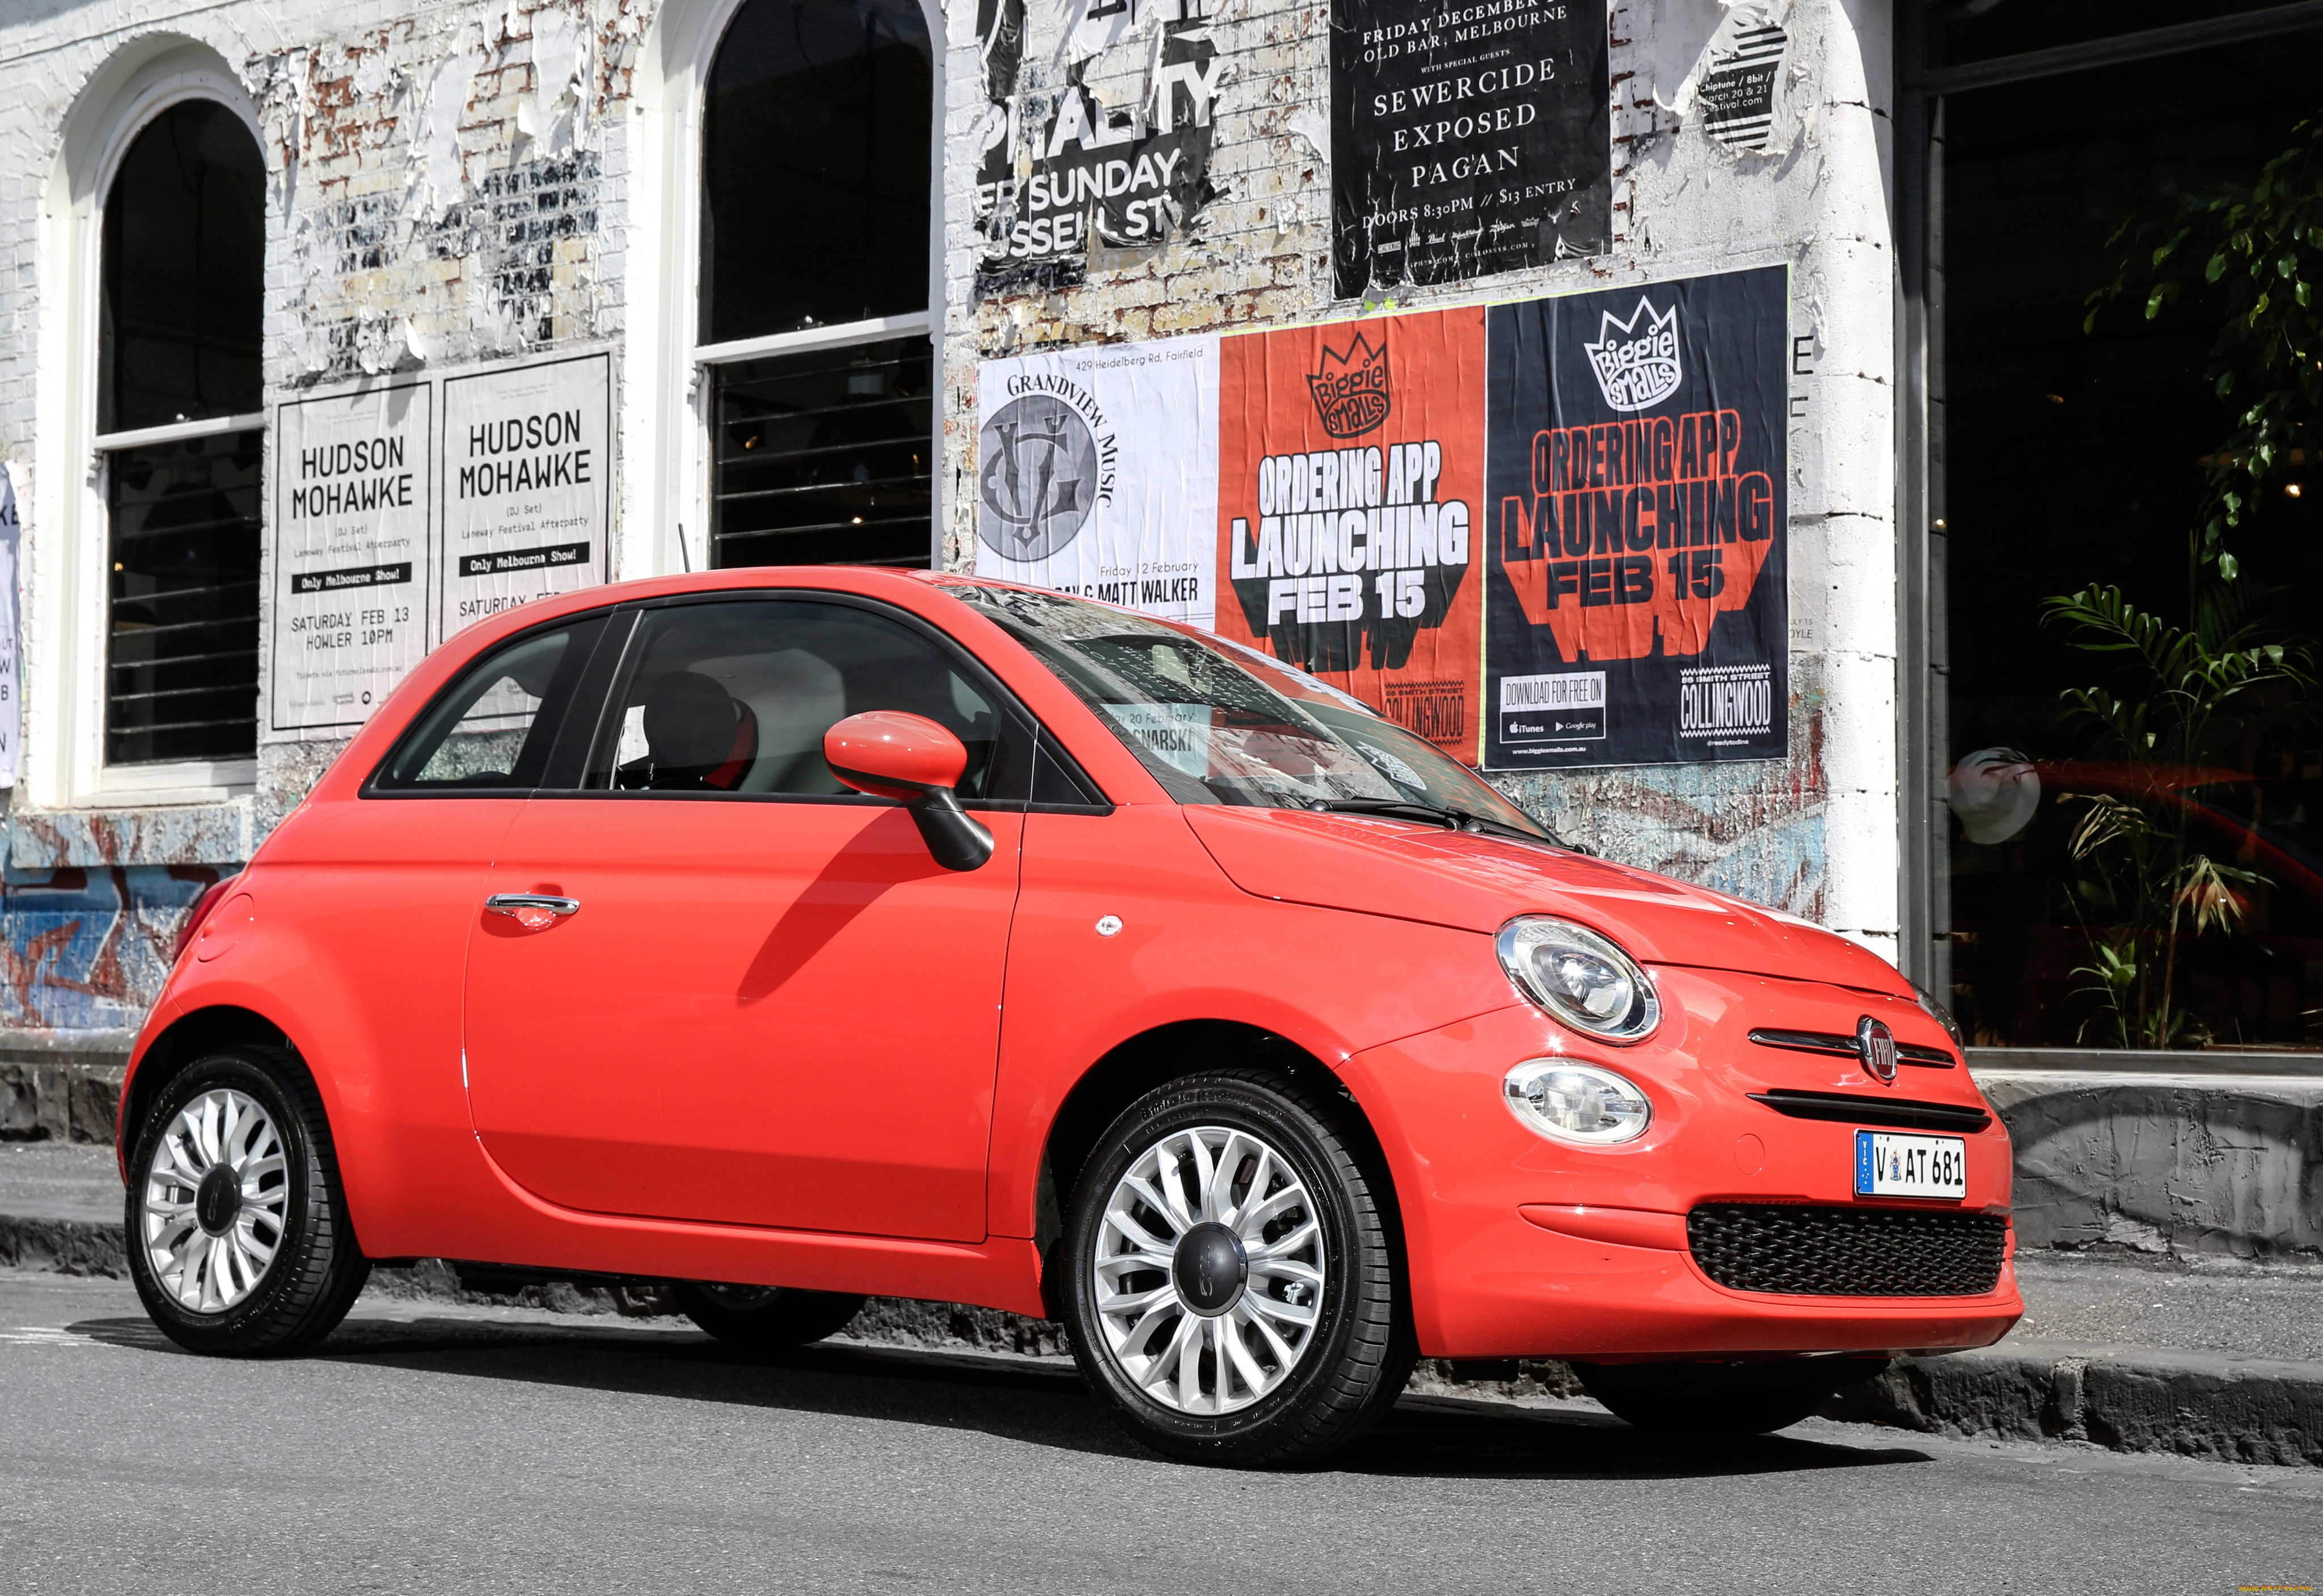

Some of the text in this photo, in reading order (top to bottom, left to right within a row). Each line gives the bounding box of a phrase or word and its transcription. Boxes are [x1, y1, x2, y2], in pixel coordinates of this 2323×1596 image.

[1363, 0, 1539, 45] FRIDAY DECEMBER
[1364, 44, 1400, 63] OLD
[1455, 6, 1567, 43] MELBOURNE
[1421, 49, 1510, 74] WITH SPECIAL GUESTS
[1374, 57, 1555, 117] SEWERCIDE
[1700, 81, 1736, 92] Chiptune
[1747, 74, 1763, 84] 8bit
[1705, 84, 1767, 102] arch 20 & 21
[1704, 97, 1762, 112] estival.com
[1393, 103, 1536, 153] EXPOSED
[1029, 148, 1181, 211] SUNDAY
[1412, 146, 1519, 188] PAGAN
[1362, 207, 1418, 230] DOORS
[1424, 196, 1473, 219] 8:30PM
[1500, 189, 1520, 204] $13
[1526, 179, 1576, 198] ENTRY
[1076, 348, 1203, 371] 429 Heidelberg Rd, Fairfield
[1595, 324, 1673, 380] Biggie
[1315, 358, 1384, 409] Biggie
[470, 409, 580, 458] HUDSON
[1007, 374, 1119, 509] GRANDVIEW MUSIC
[1535, 410, 1739, 493] ORDERING APP
[302, 435, 403, 479] HUDSON
[461, 449, 590, 499] MOHAWKE
[293, 474, 412, 519] MOHAWKE
[1259, 441, 1441, 517] ORDERING APP
[462, 517, 589, 539] Laneway Festival Afterparty
[506, 503, 542, 518] (DJ Set)
[1503, 473, 1771, 562] LAUNCHING
[294, 537, 410, 558] Laneway Festival Afterparty
[470, 548, 577, 572] Only Melbourne Show!
[1230, 500, 1469, 580] LAUNCHING
[301, 568, 400, 590] Only Melbourne Show!
[1100, 566, 1131, 578] Friday
[1152, 562, 1199, 574] February
[1546, 549, 1725, 610] FEB 15
[1098, 581, 1137, 606] MATT
[1141, 577, 1198, 604] WALKER
[1268, 570, 1426, 625] FEB 15
[292, 607, 409, 632] SATURDAY FEB 13
[307, 629, 392, 650] HOWLER 10PM
[1506, 678, 1601, 706] DOWNLOAD FOR FREE ON
[1730, 672, 1770, 681] STREET
[1129, 713, 1142, 723] 20
[1146, 712, 1195, 724] February
[1680, 680, 1771, 730] COLLINGWOOD
[1565, 722, 1585, 731] Google
[1512, 746, 1586, 755] www.biggiesmalls.com.au
[1873, 1037, 1892, 1065] FIAT
